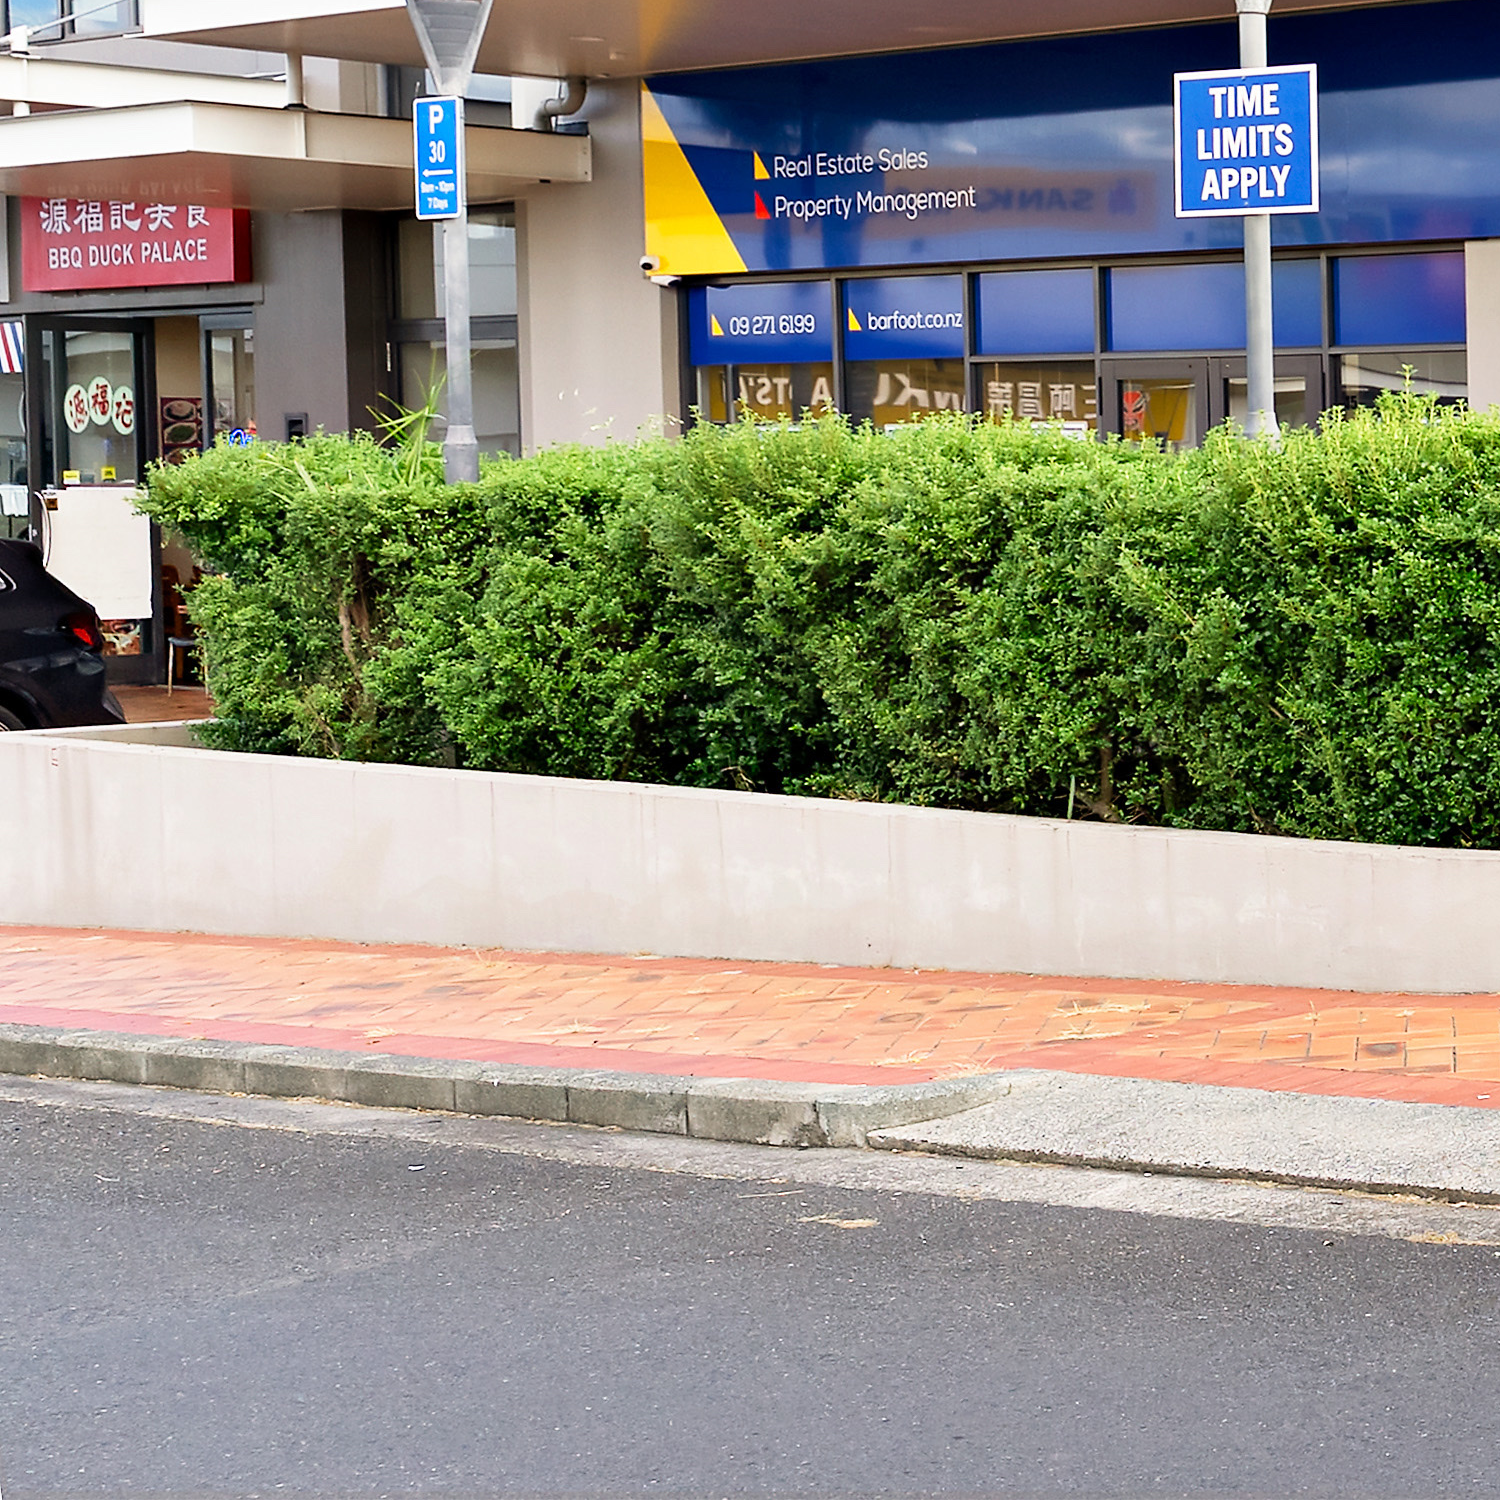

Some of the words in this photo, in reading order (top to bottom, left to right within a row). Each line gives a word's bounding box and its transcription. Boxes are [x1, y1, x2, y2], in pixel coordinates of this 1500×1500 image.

[1208, 83, 1280, 119] TIME
[429, 105, 444, 134] P
[428, 140, 445, 163] 30
[1197, 123, 1294, 160] LIMITS
[774, 153, 811, 179] Real
[816, 151, 873, 177] Estate
[878, 148, 929, 172] Sales
[1201, 165, 1291, 201] APPLY
[774, 193, 850, 222] Property
[856, 185, 976, 220] Management
[48, 247, 83, 269] BBQ
[88, 243, 134, 268] DUCK
[141, 238, 207, 264] PALACE
[729, 316, 749, 335] 09
[752, 315, 776, 335] 271
[779, 314, 815, 335] 6199
[868, 311, 963, 331] barfoot.co.nz
